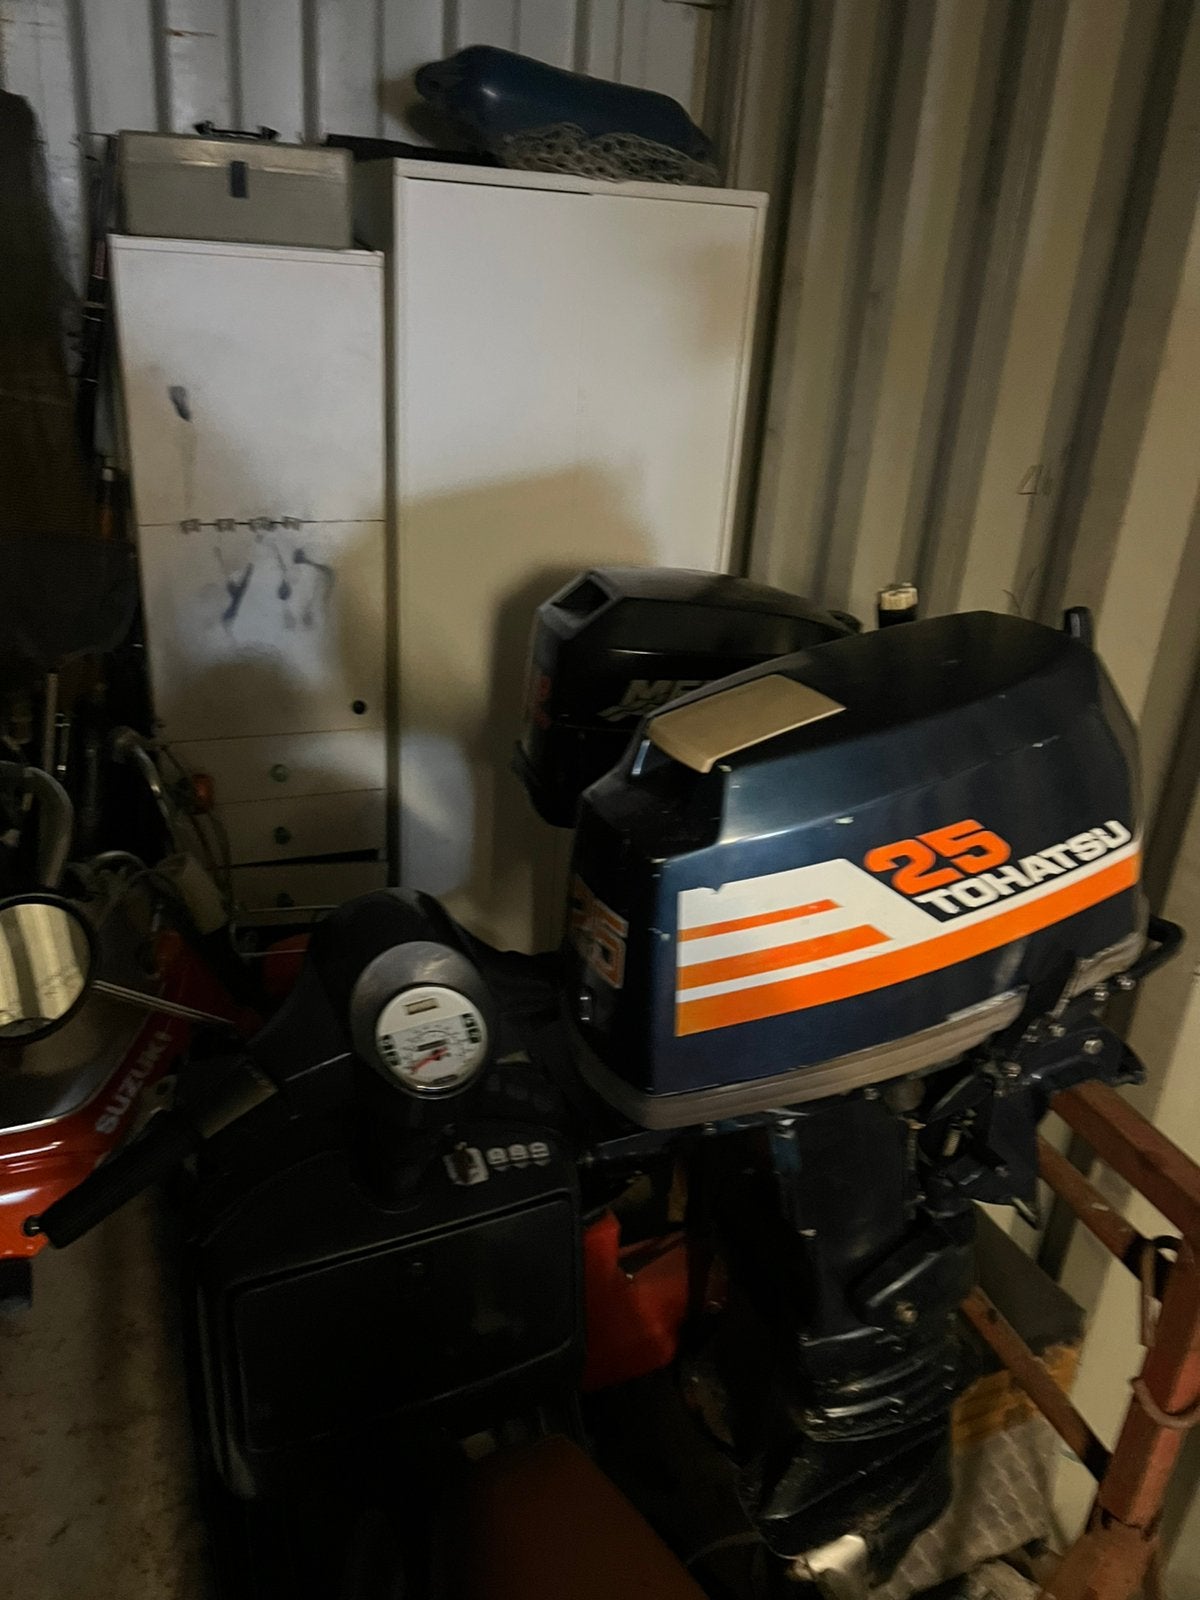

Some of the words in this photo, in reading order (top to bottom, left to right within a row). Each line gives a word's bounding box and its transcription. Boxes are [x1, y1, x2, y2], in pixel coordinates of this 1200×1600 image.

[864, 818, 1012, 896] 25
[912, 819, 1133, 915] TOHATSU
[94, 1030, 173, 1135] SUZUKI
